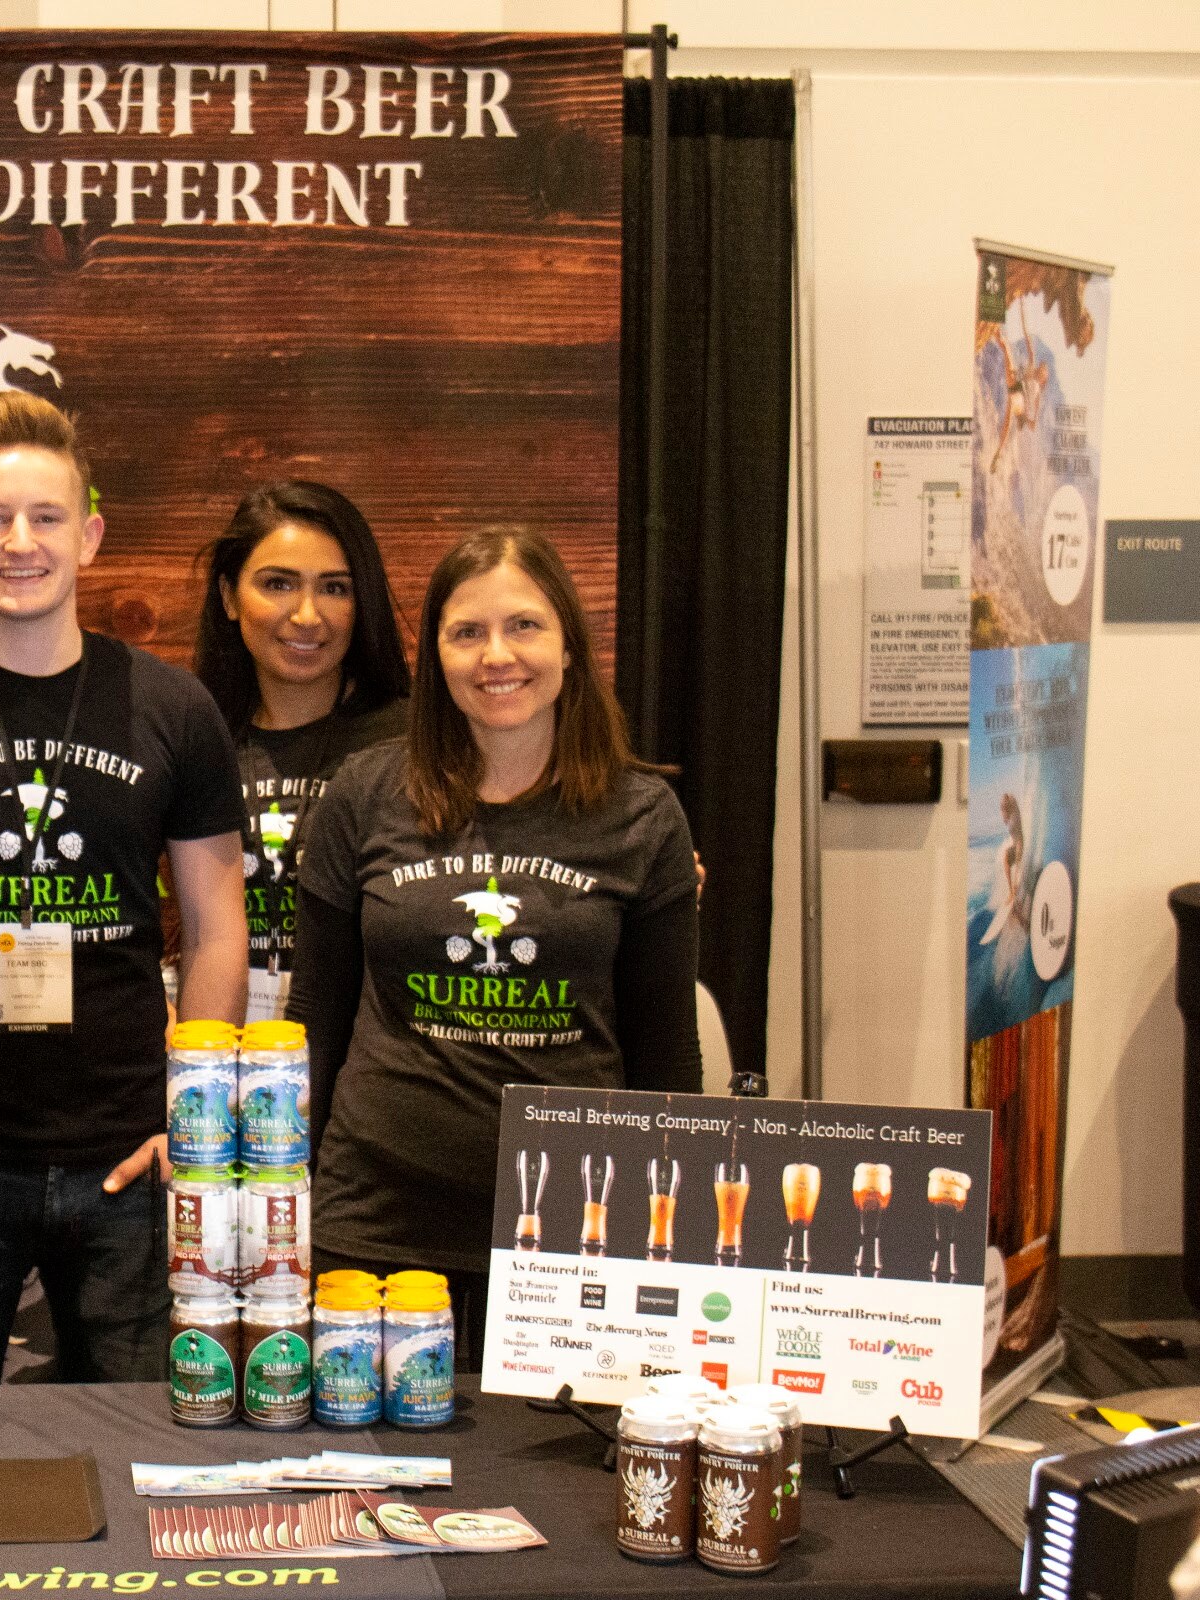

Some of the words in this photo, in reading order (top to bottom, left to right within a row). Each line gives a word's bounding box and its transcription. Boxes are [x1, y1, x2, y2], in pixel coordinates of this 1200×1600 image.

[15, 62, 268, 138] CRAFT
[304, 64, 518, 140] BEER
[873, 420, 945, 432] EVACUATION
[892, 441, 933, 449] HOWARD
[935, 441, 969, 449] STREET
[1116, 537, 1142, 551] EXIT
[1144, 537, 1183, 551] ROUTE
[940, 683, 968, 692] DISAB
[14, 738, 36, 761] BE
[256, 778, 276, 798] BE
[392, 859, 437, 888] DARE
[442, 855, 466, 875] TO
[472, 853, 495, 874] BE
[501, 855, 598, 893] DIFFERENT
[38, 906, 121, 925] COMPANY
[407, 973, 577, 1009] SURREAL
[486, 1011, 572, 1030] COMPANY
[7, 1024, 49, 1033] EXHIBITOR
[503, 1031, 547, 1048] CRAFT
[551, 1029, 583, 1046] BEER
[178, 1117, 225, 1129] SURREAL
[248, 1118, 294, 1129] SURREAL
[524, 1105, 581, 1124] Surreal
[586, 1109, 651, 1132] Brewing
[655, 1112, 731, 1137] Company
[880, 1125, 922, 1144] Craft
[927, 1128, 965, 1147] Beer
[182, 1143, 204, 1151] HAZY
[207, 1143, 221, 1151] IPA
[509, 1261, 525, 1272] As
[529, 1262, 579, 1277] featured
[582, 1267, 599, 1278] in:
[526, 1280, 559, 1291] Francisco
[583, 1286, 604, 1295] FOOD
[771, 1281, 801, 1294] Find
[804, 1286, 824, 1295] us:
[508, 1289, 557, 1305] Chronicle
[583, 1298, 603, 1307] WINE
[505, 1313, 544, 1325] RUNNER'S
[770, 1303, 942, 1327] www.SurrealBrewing.com
[586, 1322, 601, 1333] The
[603, 1323, 643, 1338] Mercury
[644, 1327, 668, 1338] News
[776, 1326, 824, 1343] WHOLE
[648, 1344, 676, 1353] KQED
[778, 1339, 821, 1354] FOODS
[848, 1338, 882, 1354] Total
[896, 1341, 935, 1358] Wine
[176, 1359, 215, 1371] SURREAL
[262, 1361, 302, 1372] SURREAL
[324, 1377, 369, 1388] SURREAL
[582, 1371, 629, 1381] REFINERY29
[777, 1373, 821, 1388] BevMo!
[195, 1386, 233, 1403] PORTER
[901, 1378, 944, 1400] Cub
[327, 1402, 349, 1410] HAZY
[352, 1402, 366, 1410] IPA
[414, 1403, 438, 1411] HAZY
[647, 1450, 681, 1462] PORTER
[724, 1460, 759, 1473] PORTER
[625, 1527, 670, 1544] SURREAL
[702, 1538, 747, 1555] SURREAL
